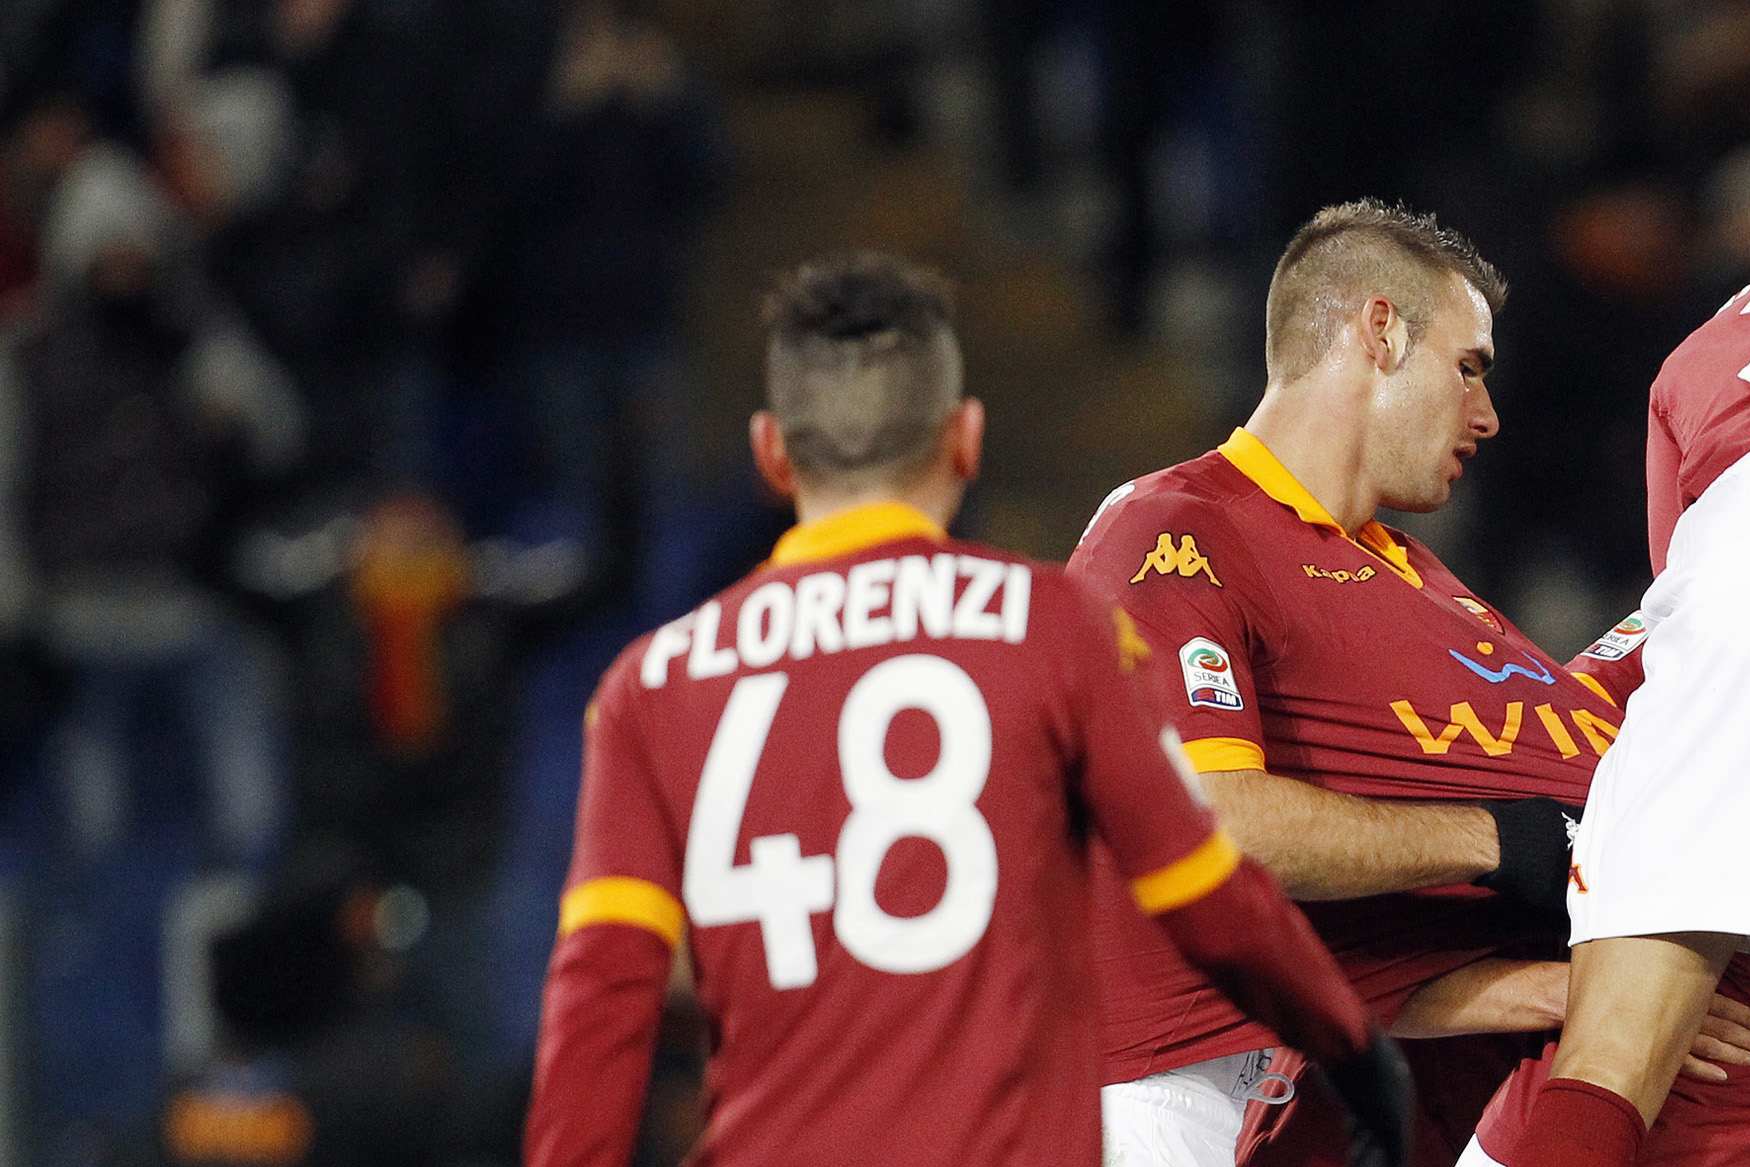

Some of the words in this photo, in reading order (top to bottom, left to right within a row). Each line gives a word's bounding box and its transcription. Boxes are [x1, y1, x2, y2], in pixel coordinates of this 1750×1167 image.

[641, 552, 1032, 689] FLORENZI
[1214, 690, 1237, 706] TIM
[682, 652, 999, 991] 48
